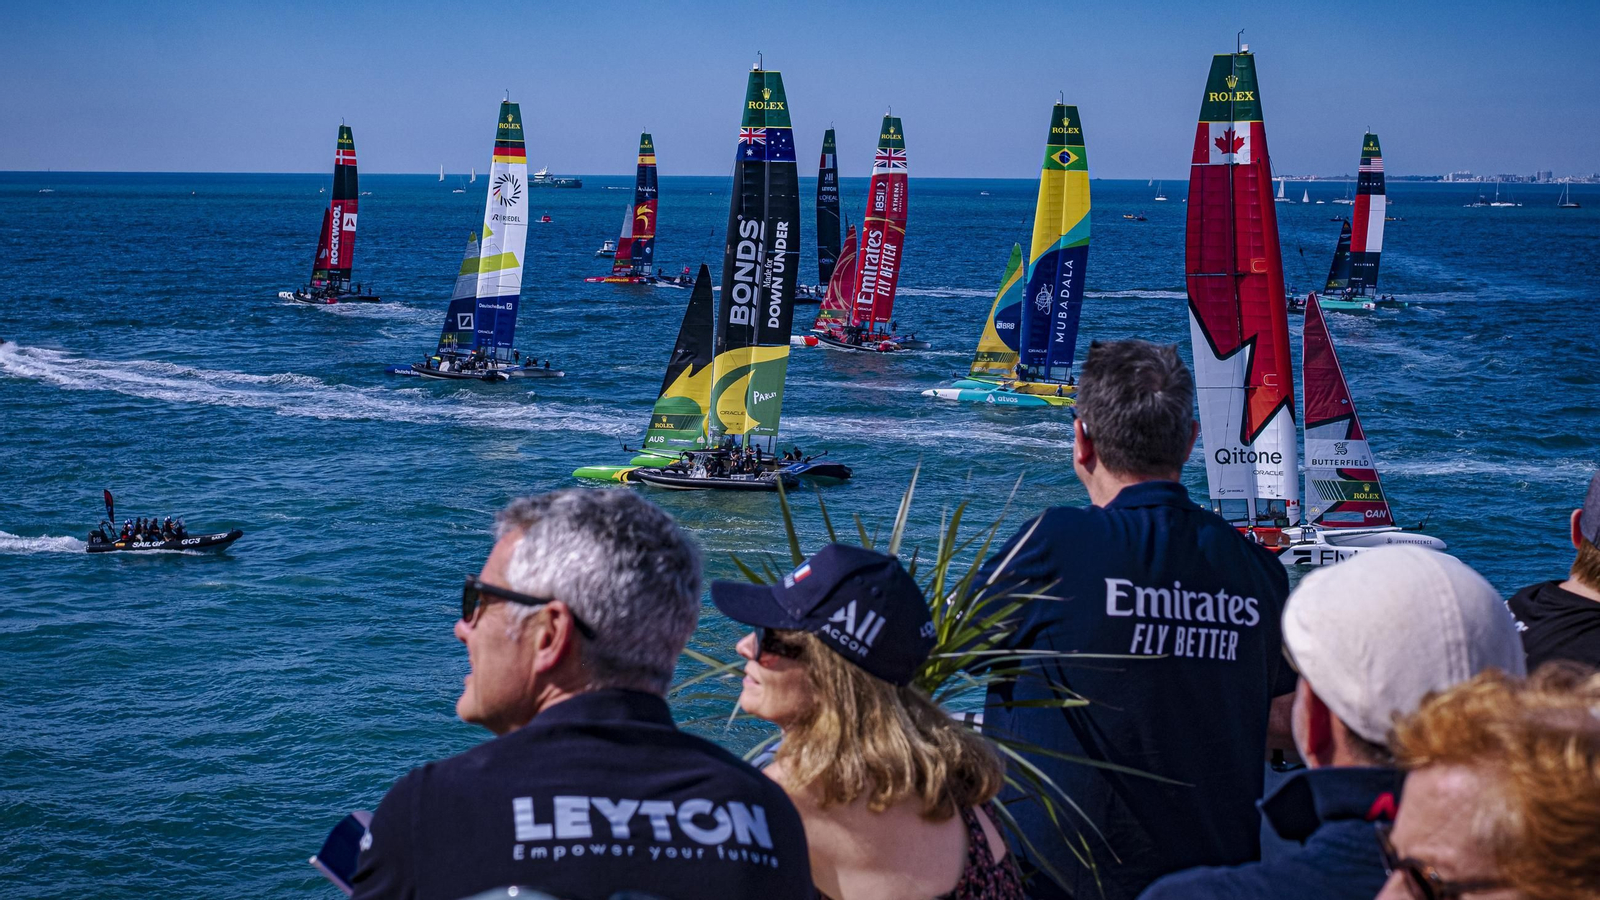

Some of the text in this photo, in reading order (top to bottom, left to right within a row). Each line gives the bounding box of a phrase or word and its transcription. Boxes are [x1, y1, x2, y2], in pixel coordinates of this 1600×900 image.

[748, 101, 785, 110] ROLEX
[1209, 91, 1255, 102] ROLEX
[498, 122, 521, 130] ROLEX
[892, 182, 900, 212] ATHENA
[330, 205, 342, 265] ROCKWOOL
[729, 219, 759, 326] BONDS
[763, 258, 773, 289] Made for
[767, 221, 789, 329] DOWN UNDER
[857, 230, 883, 305] Emirates
[877, 242, 897, 297] FLY BETTER
[1055, 259, 1074, 343] MUBADALA
[1002, 322, 1015, 330] BRB
[997, 395, 1018, 403] atvos
[648, 435, 665, 443] AUS
[1214, 447, 1283, 465] Qitone
[1311, 458, 1369, 467] BUTTERFIELD
[1252, 469, 1284, 477] ORACLE
[1353, 492, 1380, 500] ROLEX
[1365, 509, 1387, 518] CAN
[1104, 577, 1260, 627] Emirates
[820, 623, 869, 658] ACCOR
[1129, 623, 1239, 661] FLY BETTER
[512, 795, 774, 849] LEYTON
[512, 844, 779, 868] Empower your future
